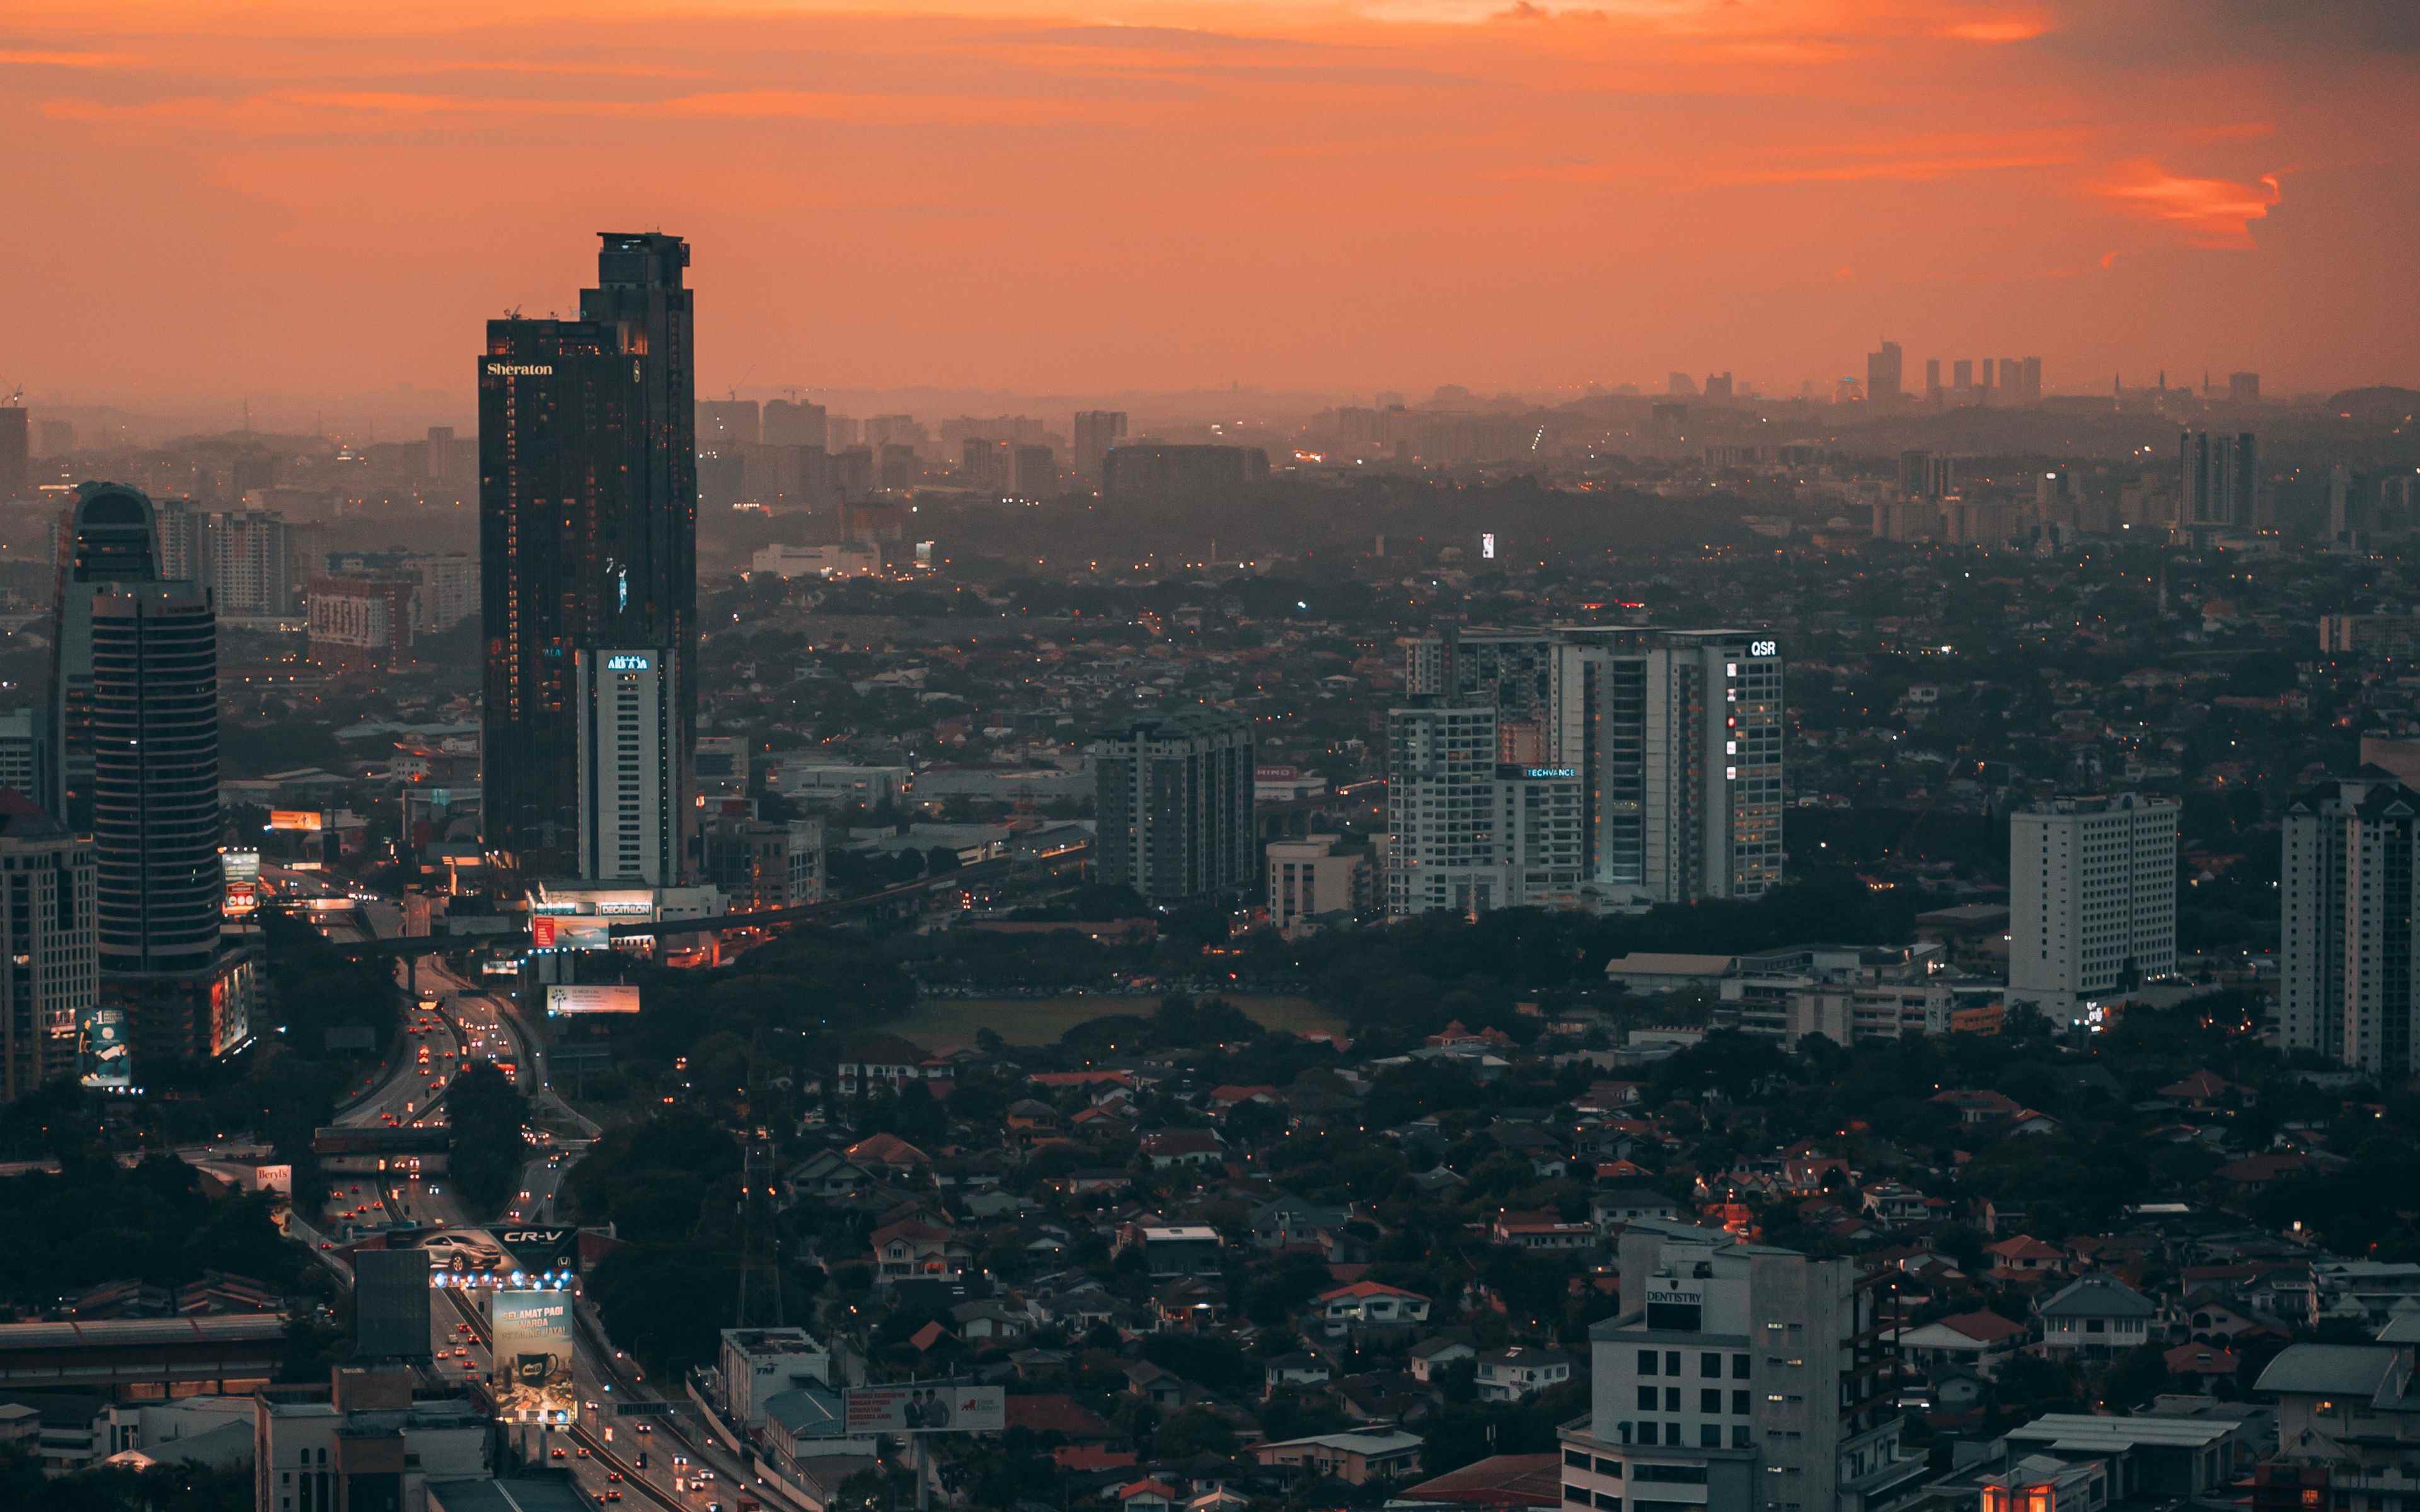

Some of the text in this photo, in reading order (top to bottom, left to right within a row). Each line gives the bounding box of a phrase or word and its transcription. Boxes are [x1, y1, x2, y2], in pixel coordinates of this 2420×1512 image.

[487, 362, 553, 375] Sheraton
[1751, 641, 1776, 656] QSR
[1527, 769, 1576, 777] TECHVANCE
[602, 905, 650, 914] DECATHLON
[257, 1169, 287, 1181] Beryl's
[504, 1231, 564, 1242] CR-V
[1647, 1291, 1702, 1303] DENTISTRY
[504, 1306, 563, 1320] SELAMAT PAGI
